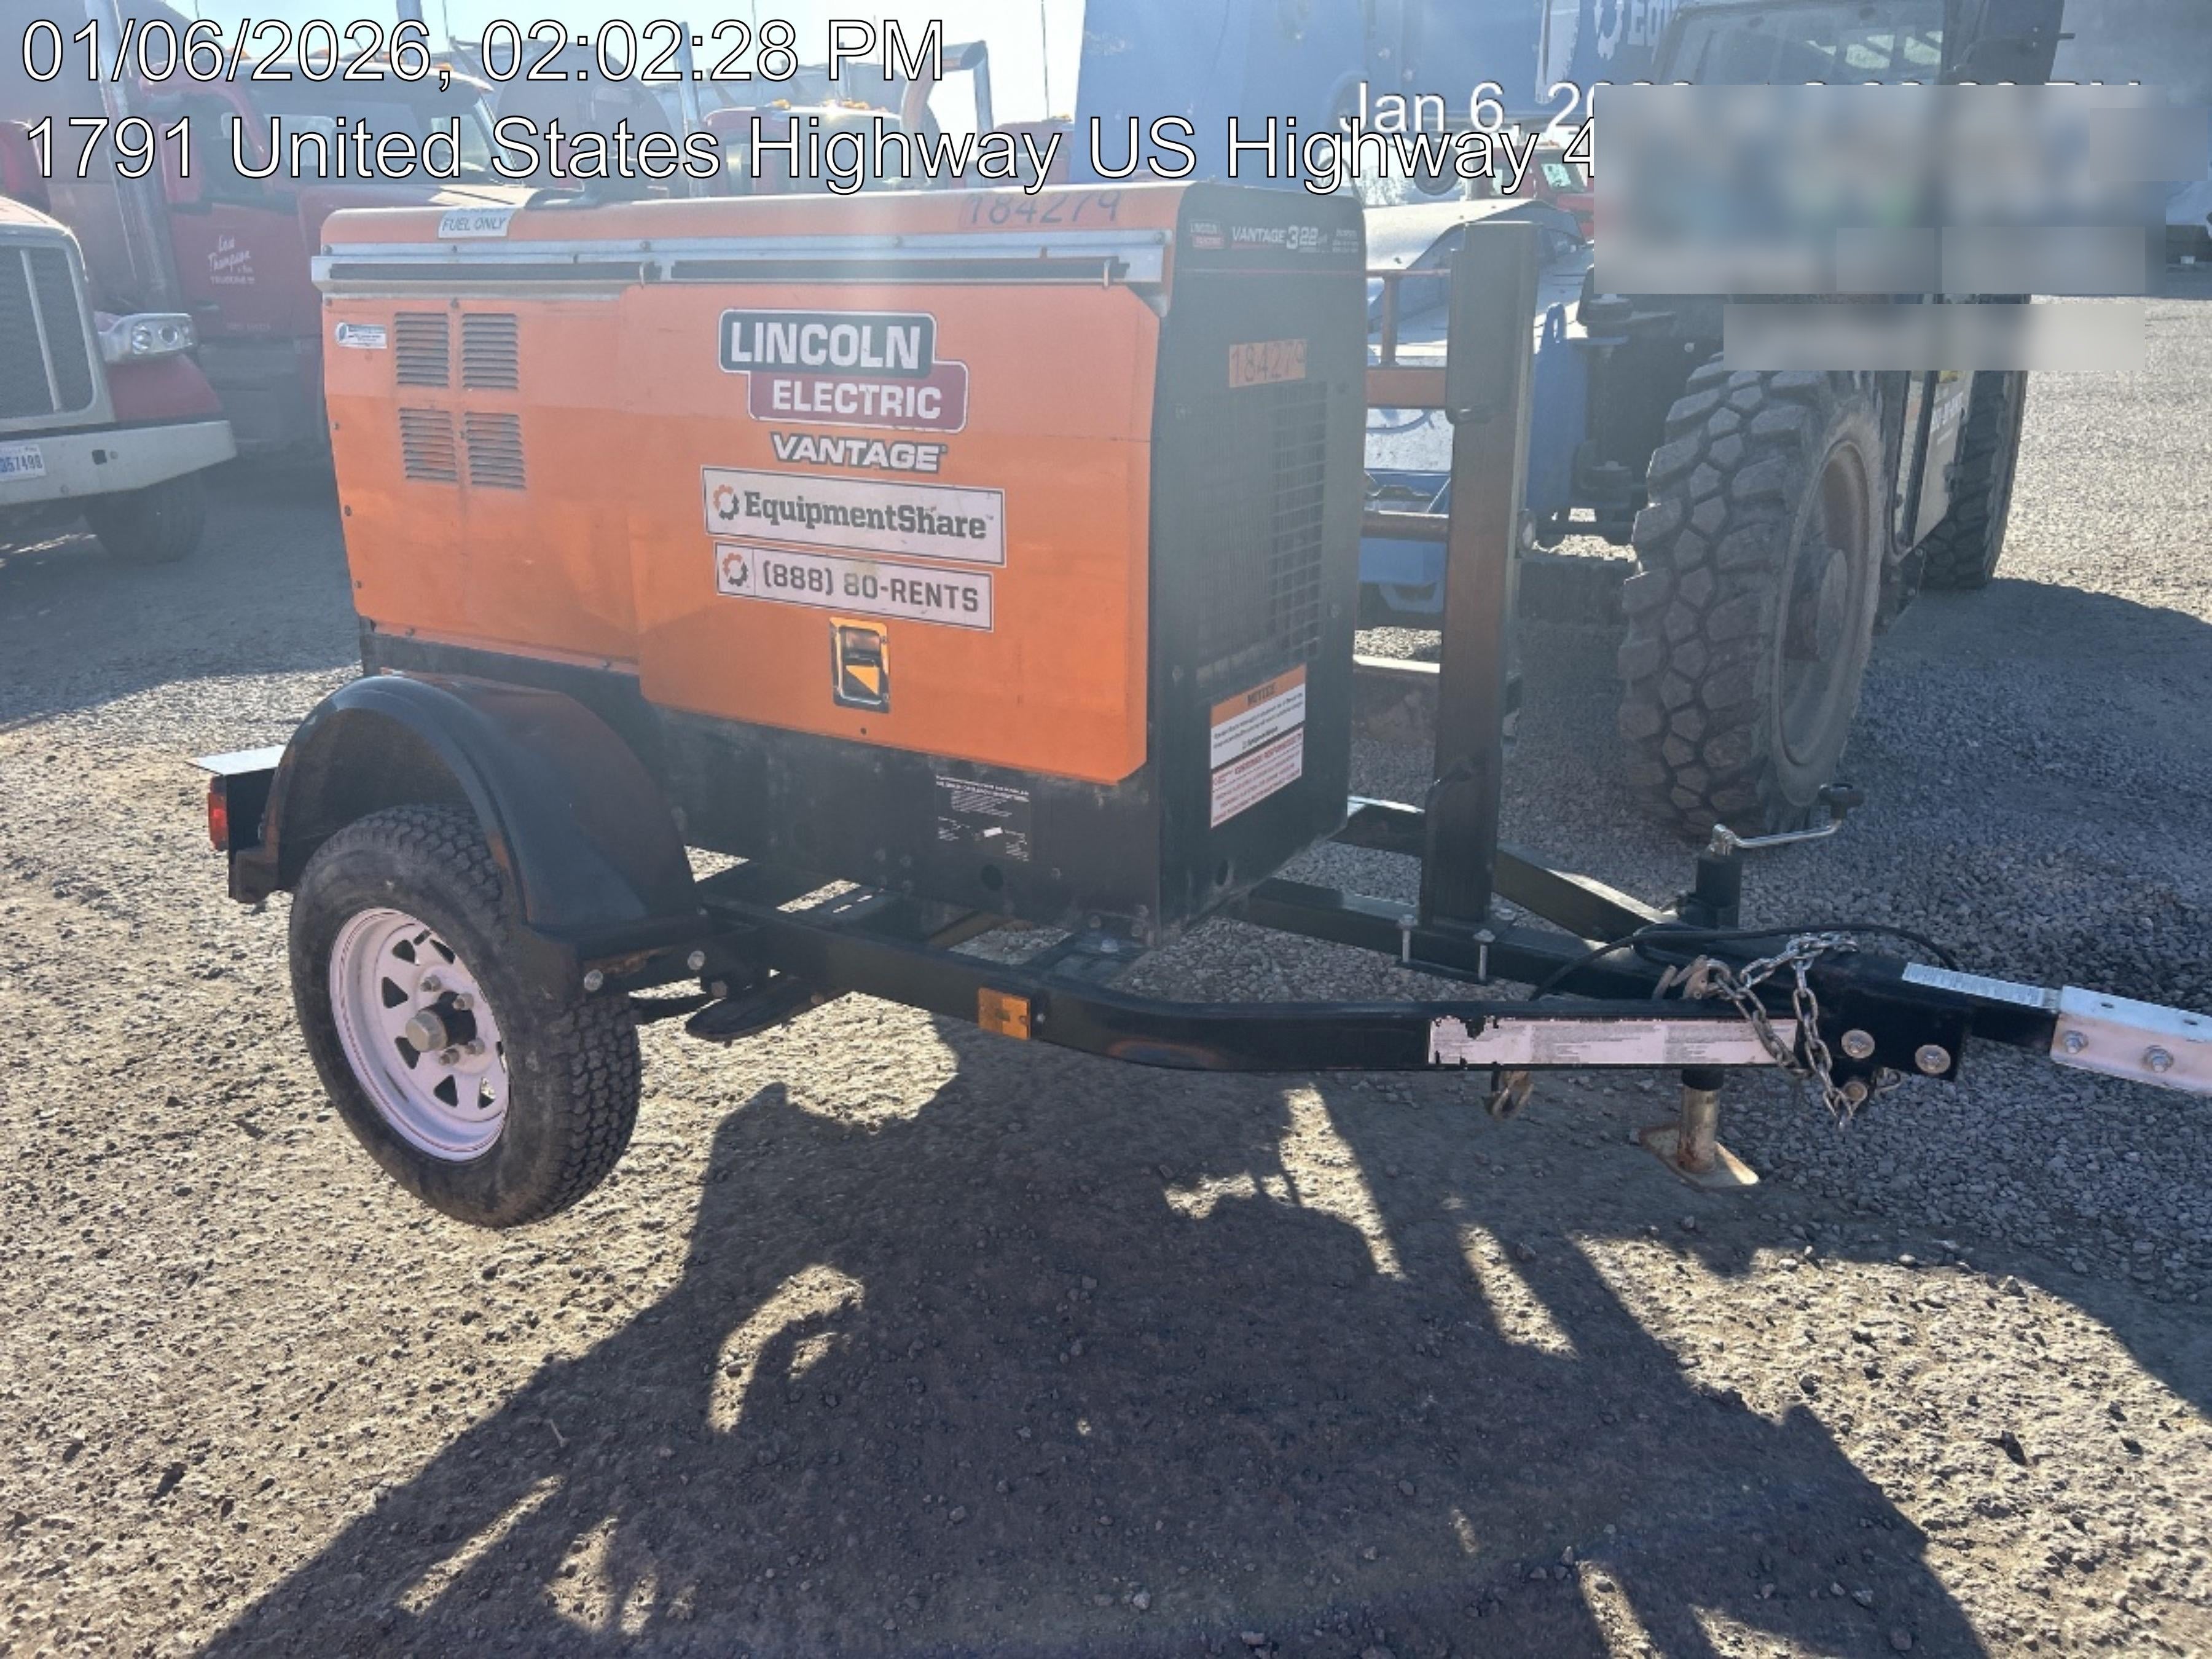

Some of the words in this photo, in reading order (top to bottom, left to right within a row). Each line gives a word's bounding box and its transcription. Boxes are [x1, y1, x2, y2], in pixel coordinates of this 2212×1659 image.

[442, 216, 471, 231] FUEL
[475, 216, 507, 230] ONLY
[965, 189, 1122, 225] 184279
[1231, 226, 1287, 244] VANTAGE
[731, 321, 920, 369] LINCOLN
[773, 379, 942, 419] ELECTRIC
[771, 433, 941, 472] VANTAGE
[762, 560, 834, 595] (888)
[843, 572, 979, 613] 80-RENTS
